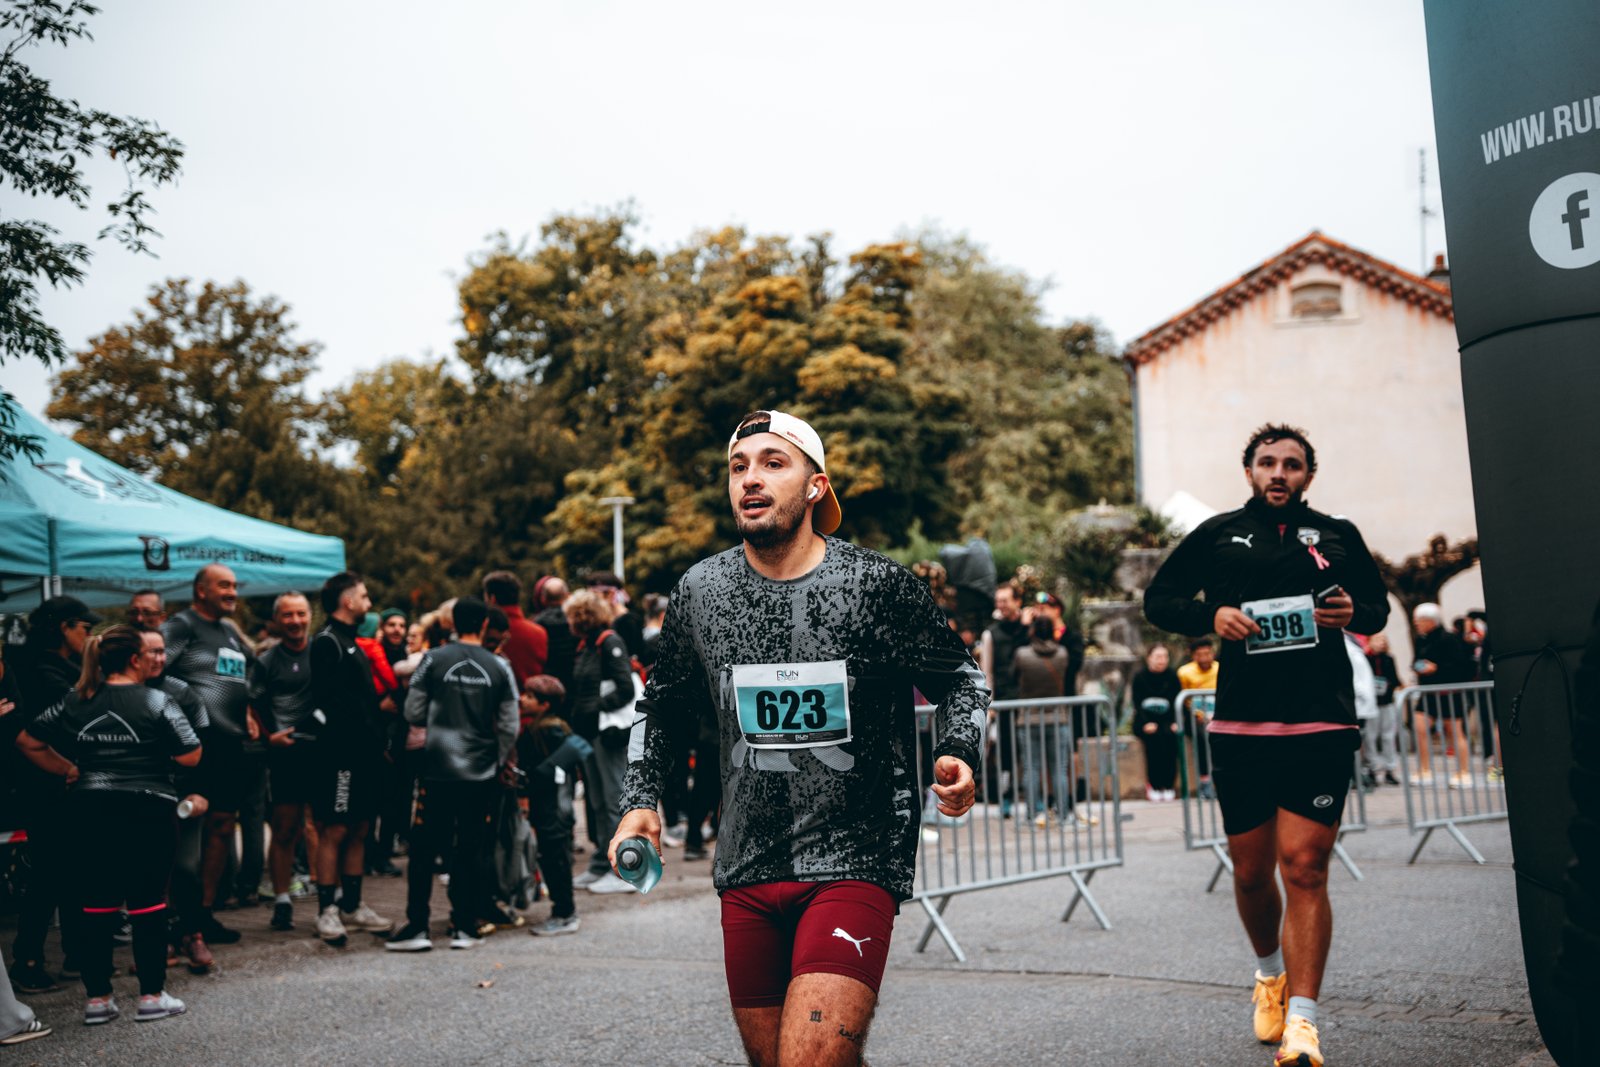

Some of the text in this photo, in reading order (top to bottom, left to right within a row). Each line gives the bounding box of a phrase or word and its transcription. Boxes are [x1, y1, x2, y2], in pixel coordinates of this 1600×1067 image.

[1255, 612, 1304, 641] 698
[756, 689, 828, 731] 623
[97, 733, 133, 743] VALLON
